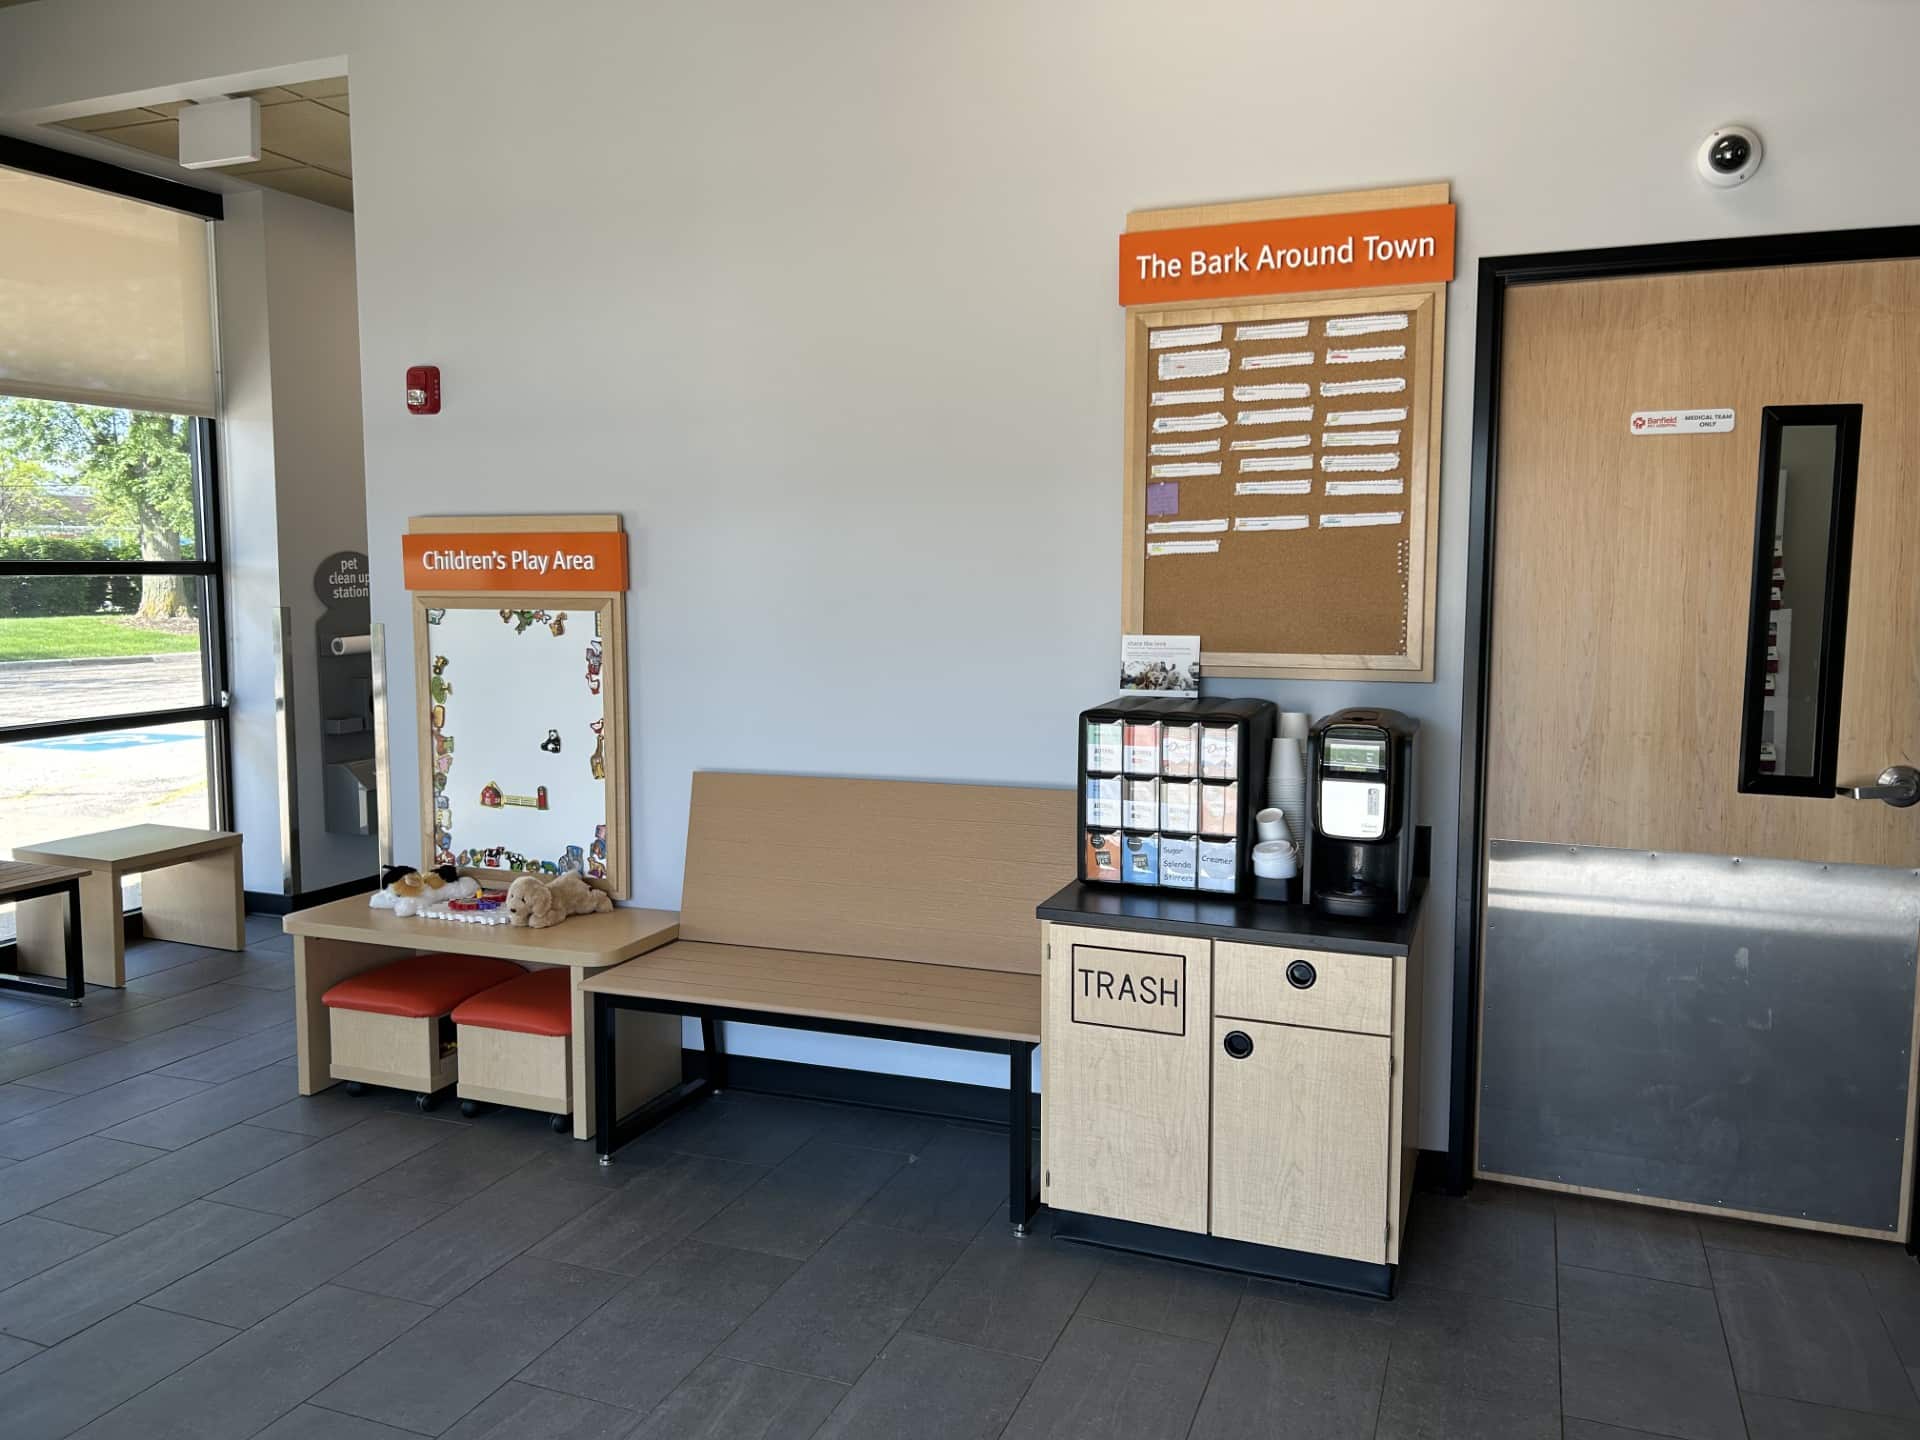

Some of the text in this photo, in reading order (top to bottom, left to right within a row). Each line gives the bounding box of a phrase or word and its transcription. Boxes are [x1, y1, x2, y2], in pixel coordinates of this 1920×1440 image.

[1136, 235, 1435, 280] The Bark Around Town
[341, 557, 358, 573] pet
[422, 550, 594, 575] Children’s Play Area
[328, 571, 370, 586] clean up
[333, 585, 369, 599] station
[1162, 846, 1184, 856] Sugar
[1201, 855, 1233, 865] Creamer
[1163, 873, 1193, 882] Stirrers
[1078, 968, 1178, 1008] TRASH
